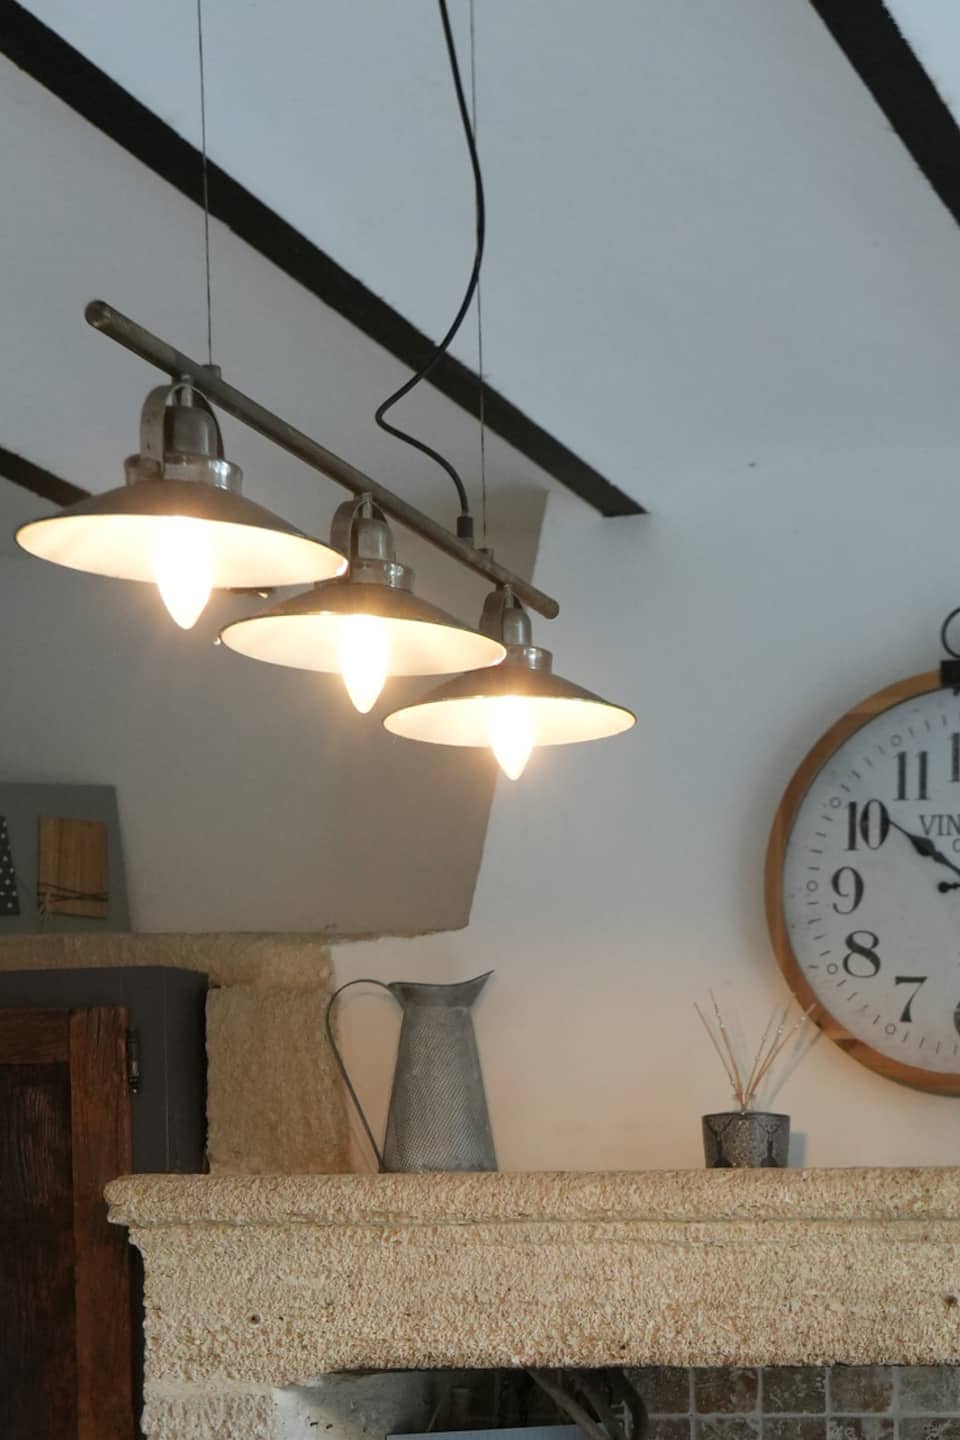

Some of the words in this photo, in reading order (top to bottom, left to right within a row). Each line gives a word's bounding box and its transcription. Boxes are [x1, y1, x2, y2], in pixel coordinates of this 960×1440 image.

[894, 750, 931, 801] 11
[844, 798, 892, 851] 10
[830, 865, 864, 915] 9
[842, 930, 881, 978] 8
[894, 975, 929, 1024] 7
